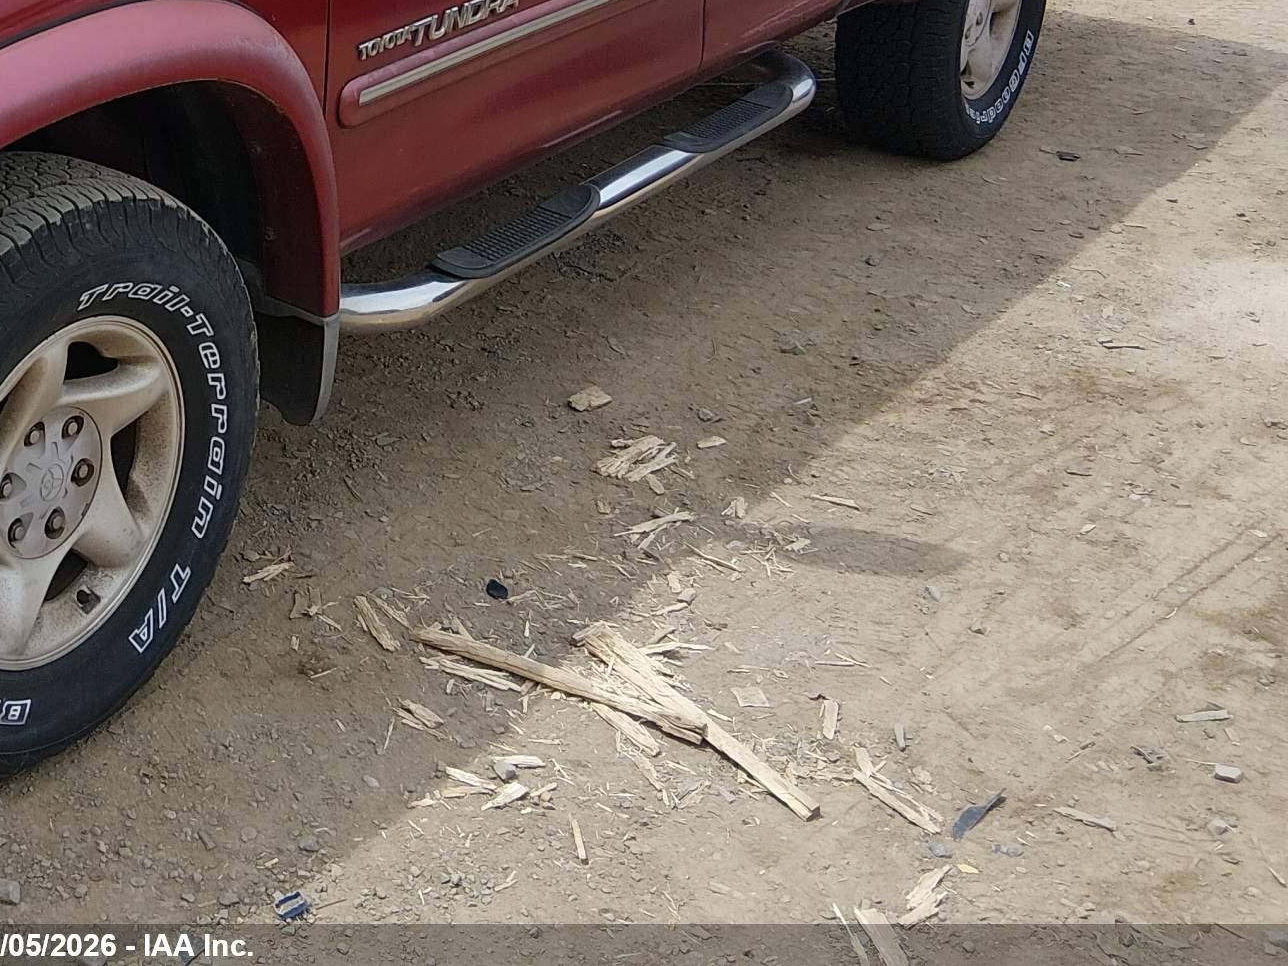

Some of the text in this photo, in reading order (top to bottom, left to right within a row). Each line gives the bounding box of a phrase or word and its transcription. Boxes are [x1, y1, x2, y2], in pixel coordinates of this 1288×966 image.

[358, 27, 413, 60] TOYOTA
[77, 282, 228, 654] Trail-Terrain T/A
